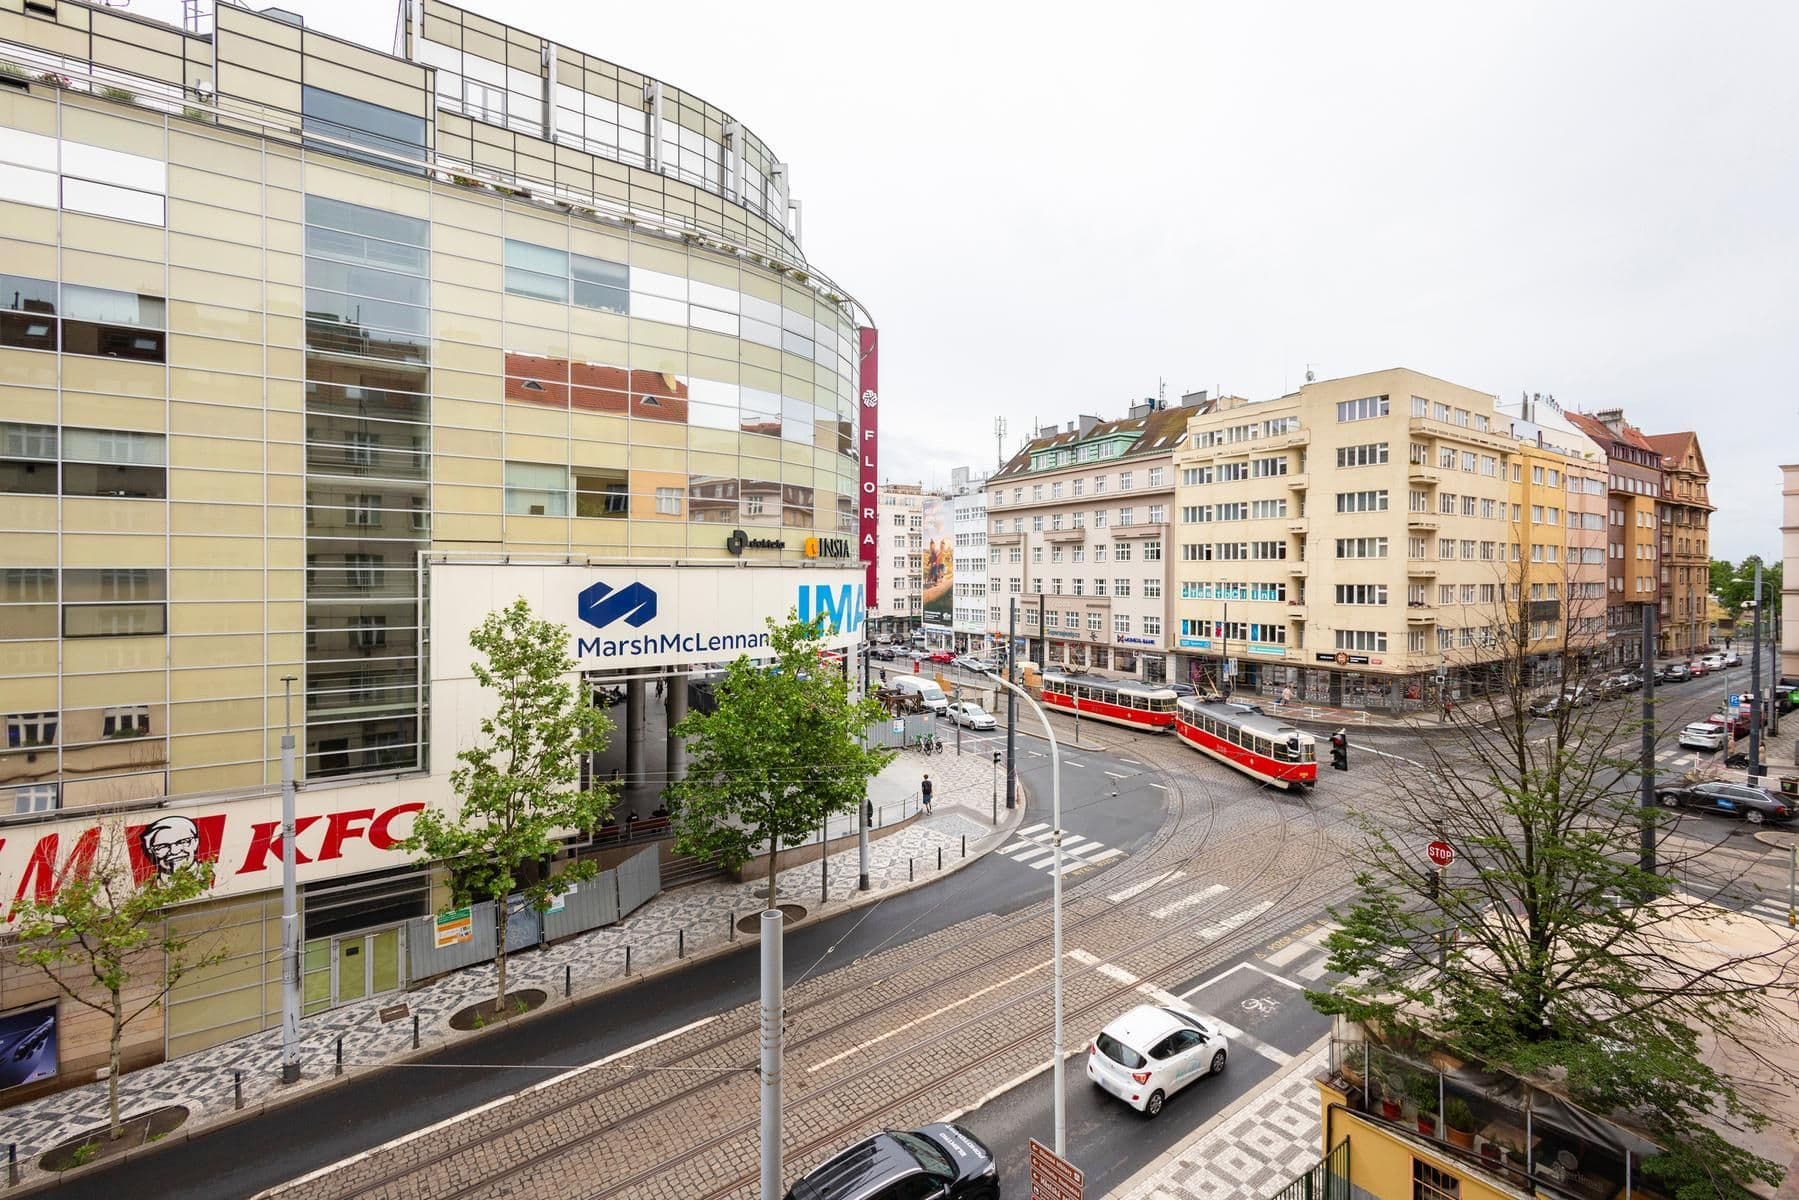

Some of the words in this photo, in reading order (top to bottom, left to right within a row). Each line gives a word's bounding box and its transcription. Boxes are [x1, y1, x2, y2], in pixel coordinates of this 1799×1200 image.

[863, 430, 875, 545] FLORA
[819, 538, 850, 558] INSIA
[578, 631, 770, 658] MarshMcLennan
[235, 802, 427, 875] KFC
[1429, 846, 1452, 860] STOP
